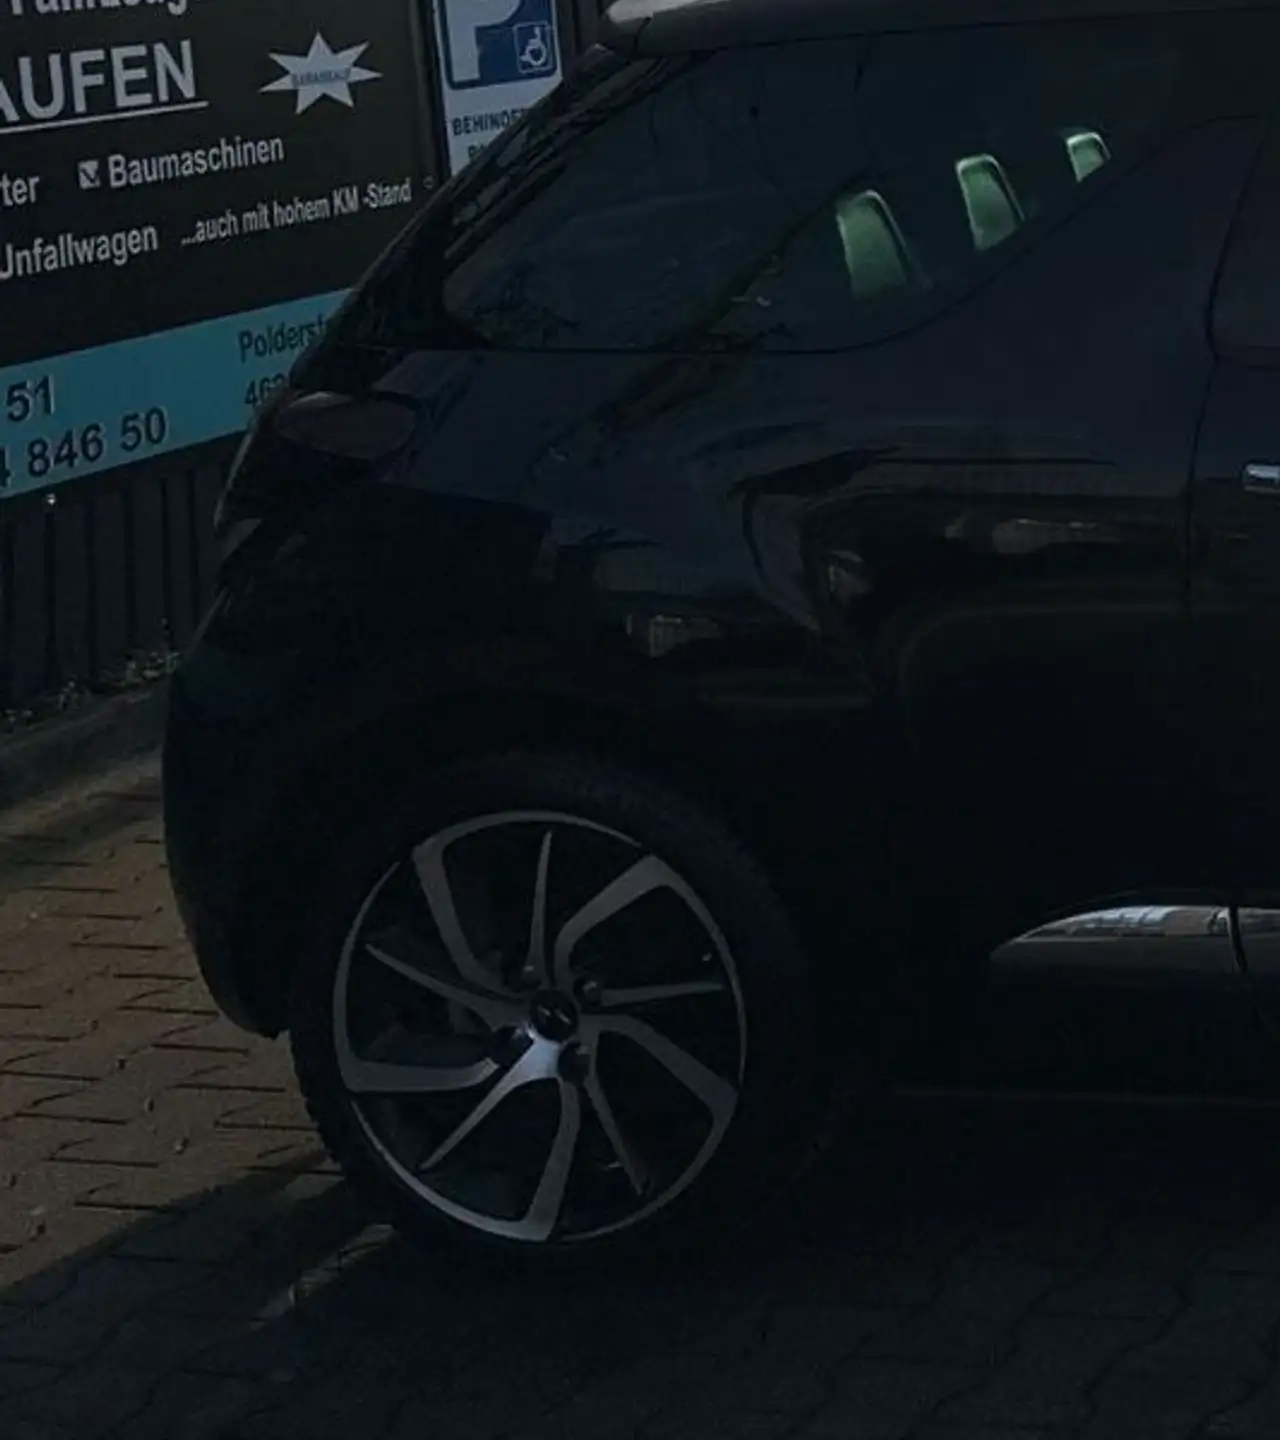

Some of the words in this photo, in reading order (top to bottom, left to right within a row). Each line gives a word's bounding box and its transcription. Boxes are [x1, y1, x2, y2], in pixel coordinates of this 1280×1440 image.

[453, 109, 525, 136] BEHINDE
[107, 135, 285, 189] Baumaschinen
[242, 200, 271, 234] mit
[273, 196, 330, 228] hohem
[332, 184, 359, 216] KM
[6, 375, 54, 423] 51
[27, 422, 104, 479] 846
[121, 407, 167, 453] 50
